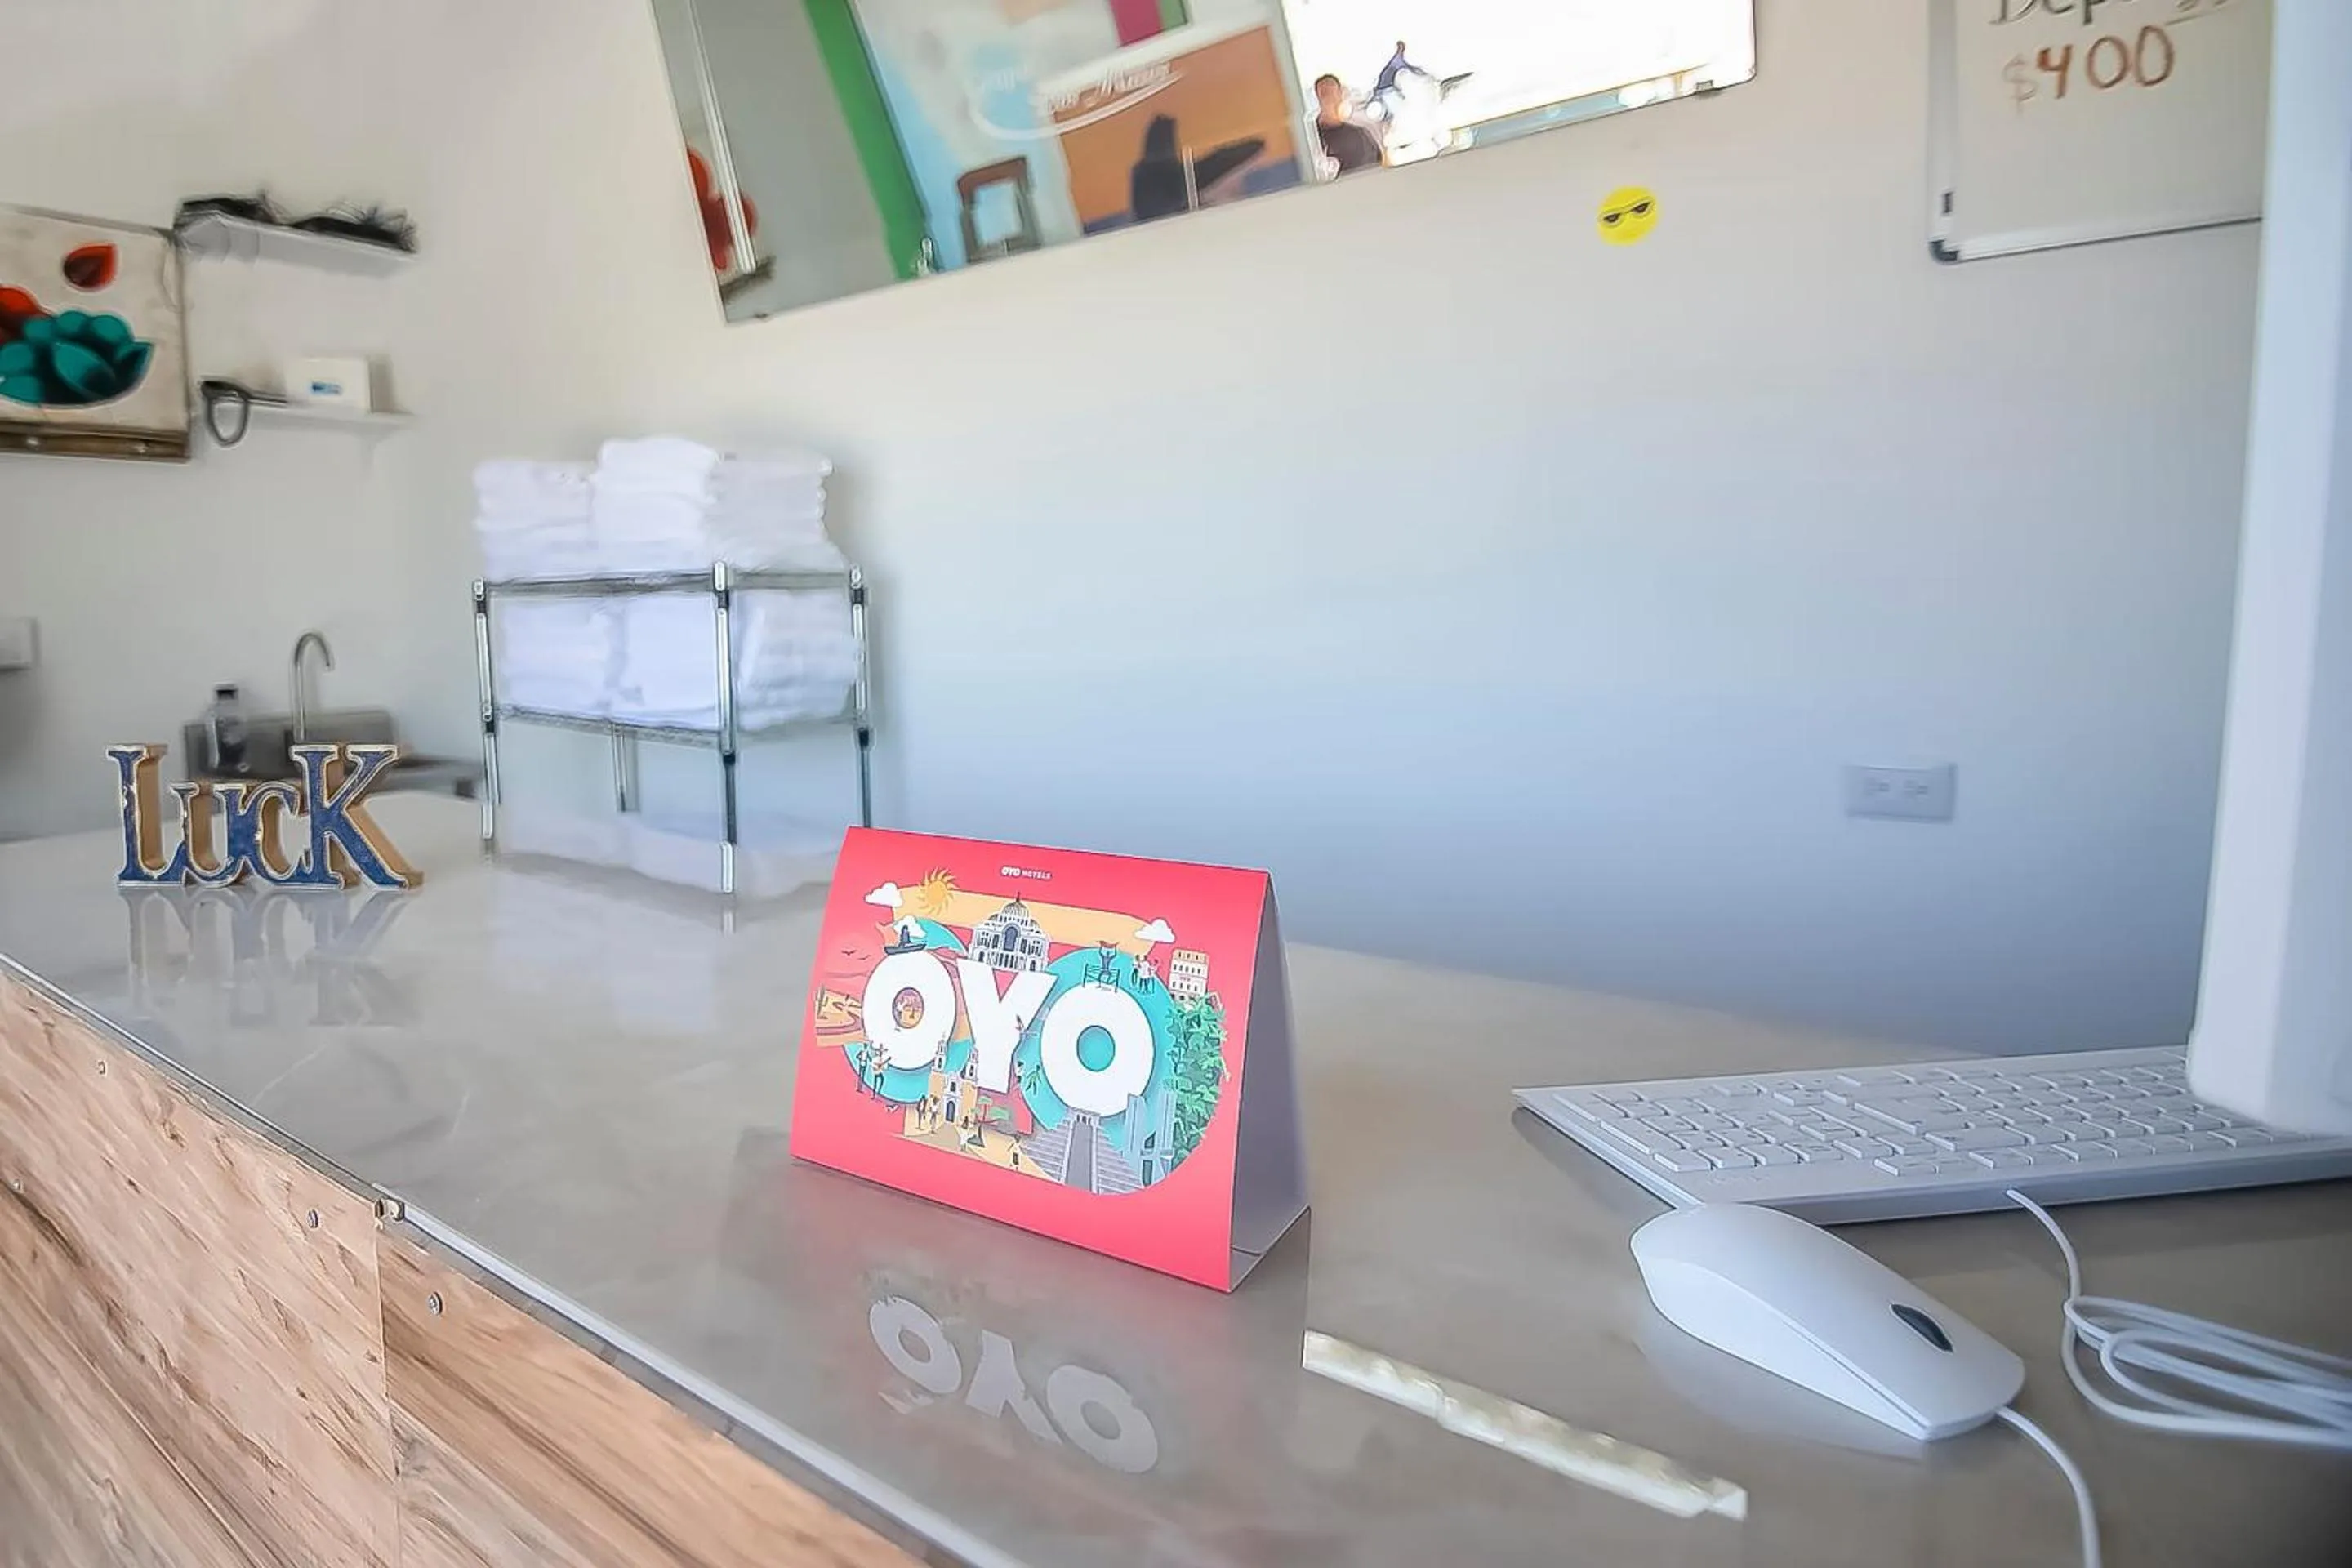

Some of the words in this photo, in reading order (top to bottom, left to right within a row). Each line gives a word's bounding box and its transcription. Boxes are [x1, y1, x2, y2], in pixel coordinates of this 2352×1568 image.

[2002, 24, 2175, 115] $400
[1001, 866, 1021, 877] OYO
[862, 951, 1156, 1118] OYO
